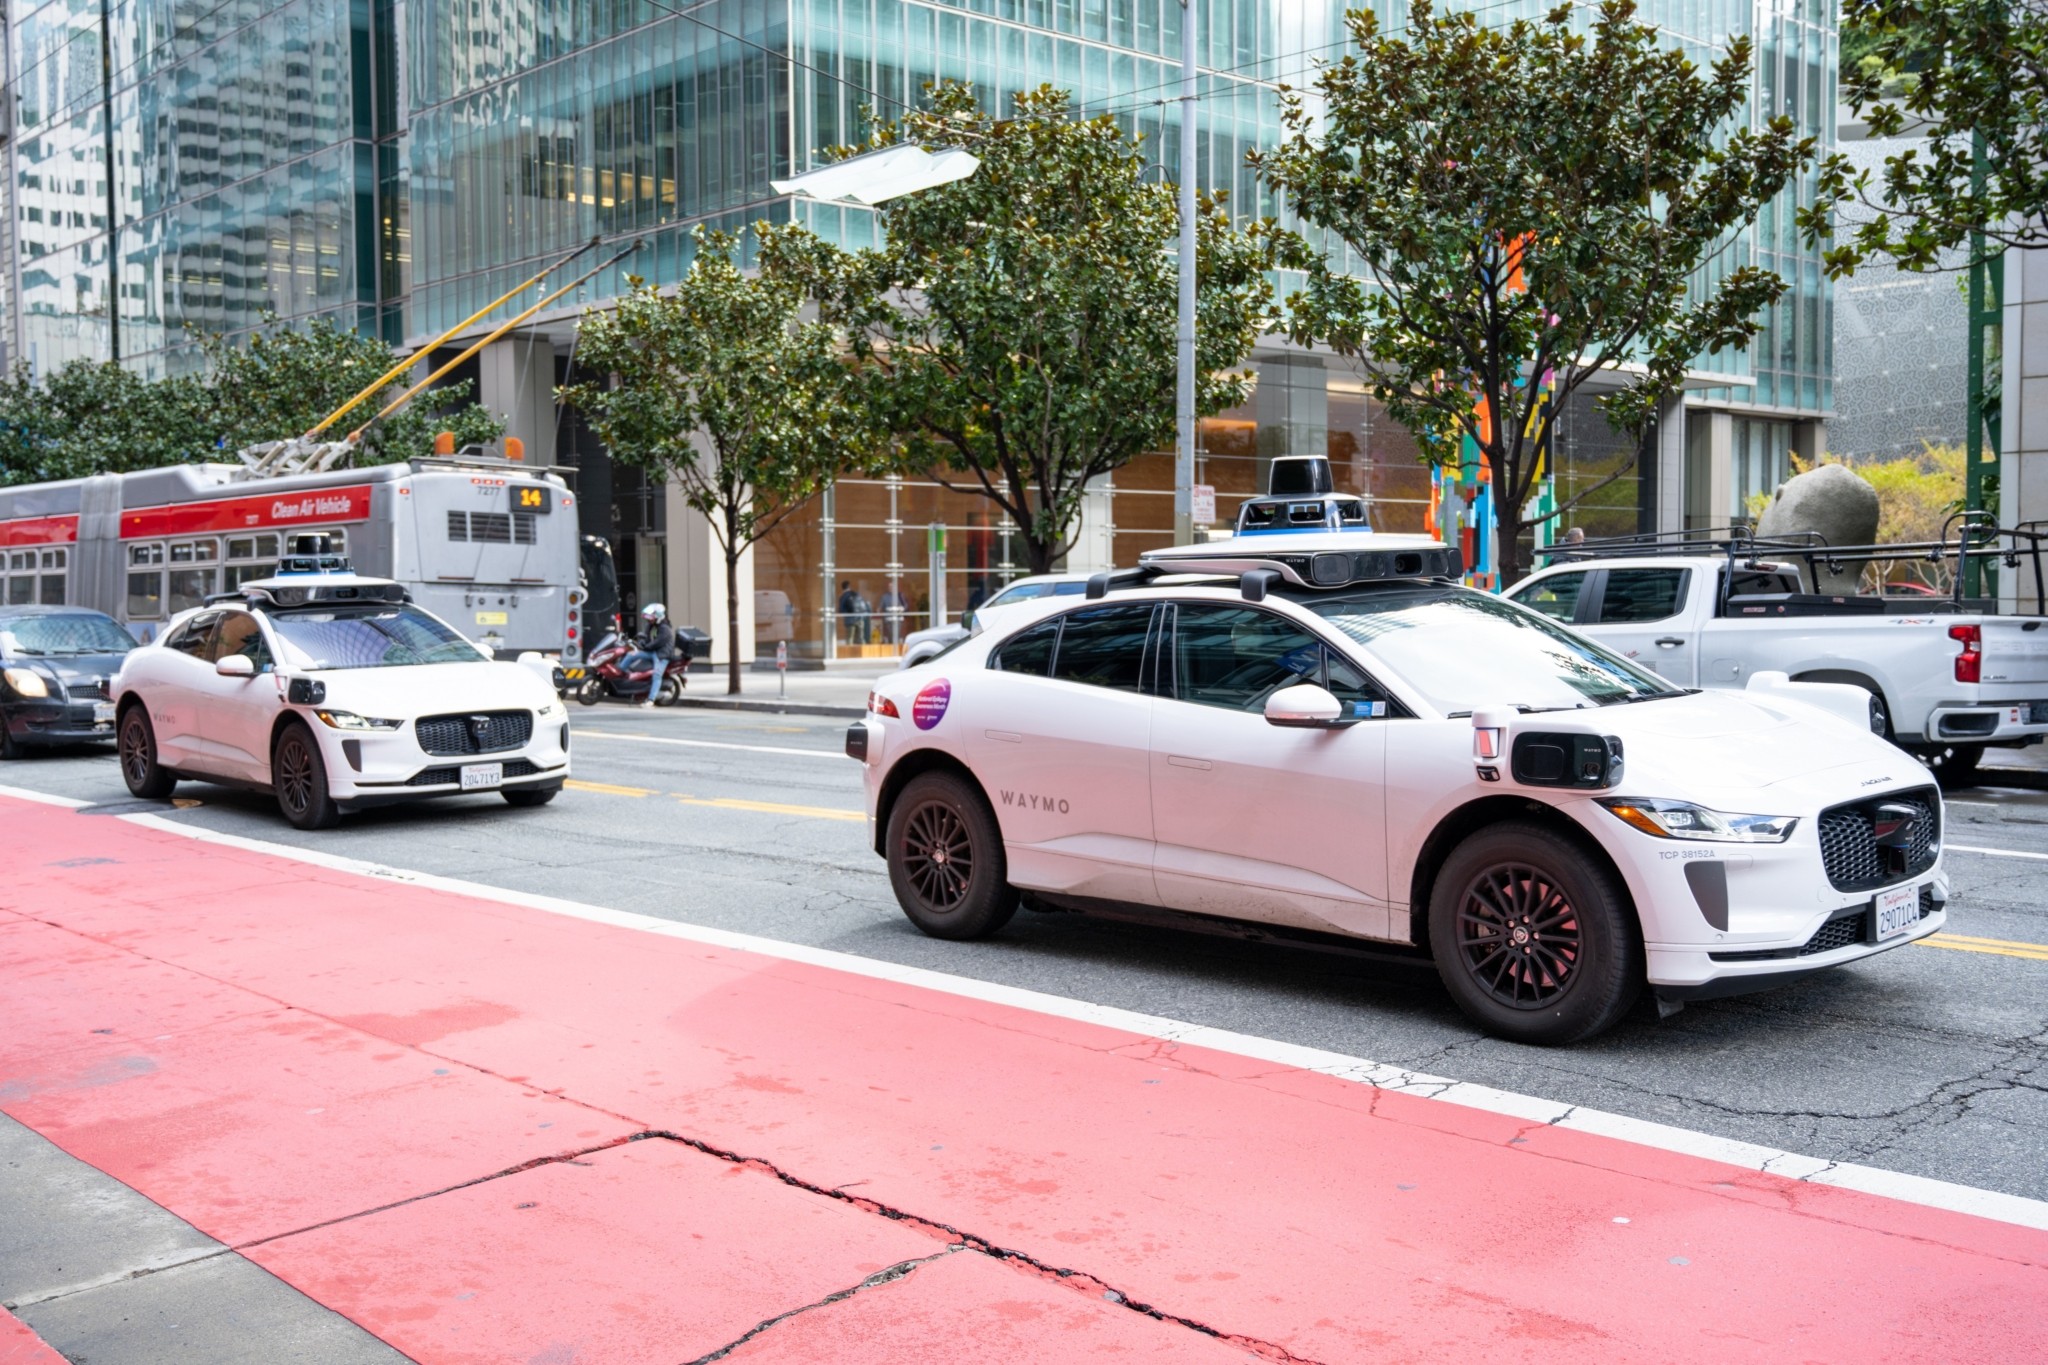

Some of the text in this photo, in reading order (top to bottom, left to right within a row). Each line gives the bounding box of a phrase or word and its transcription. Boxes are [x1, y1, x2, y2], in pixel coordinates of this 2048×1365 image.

[477, 486, 501, 496] 7277
[521, 489, 542, 507] 14
[271, 495, 352, 519] Clean Air Vehicle
[464, 772, 500, 786] 20471Y3
[1000, 789, 1070, 815] WAYMO
[1659, 849, 1716, 860] TCP 38152A
[1884, 891, 1912, 907] California
[1880, 901, 1918, 934] 29071C4
